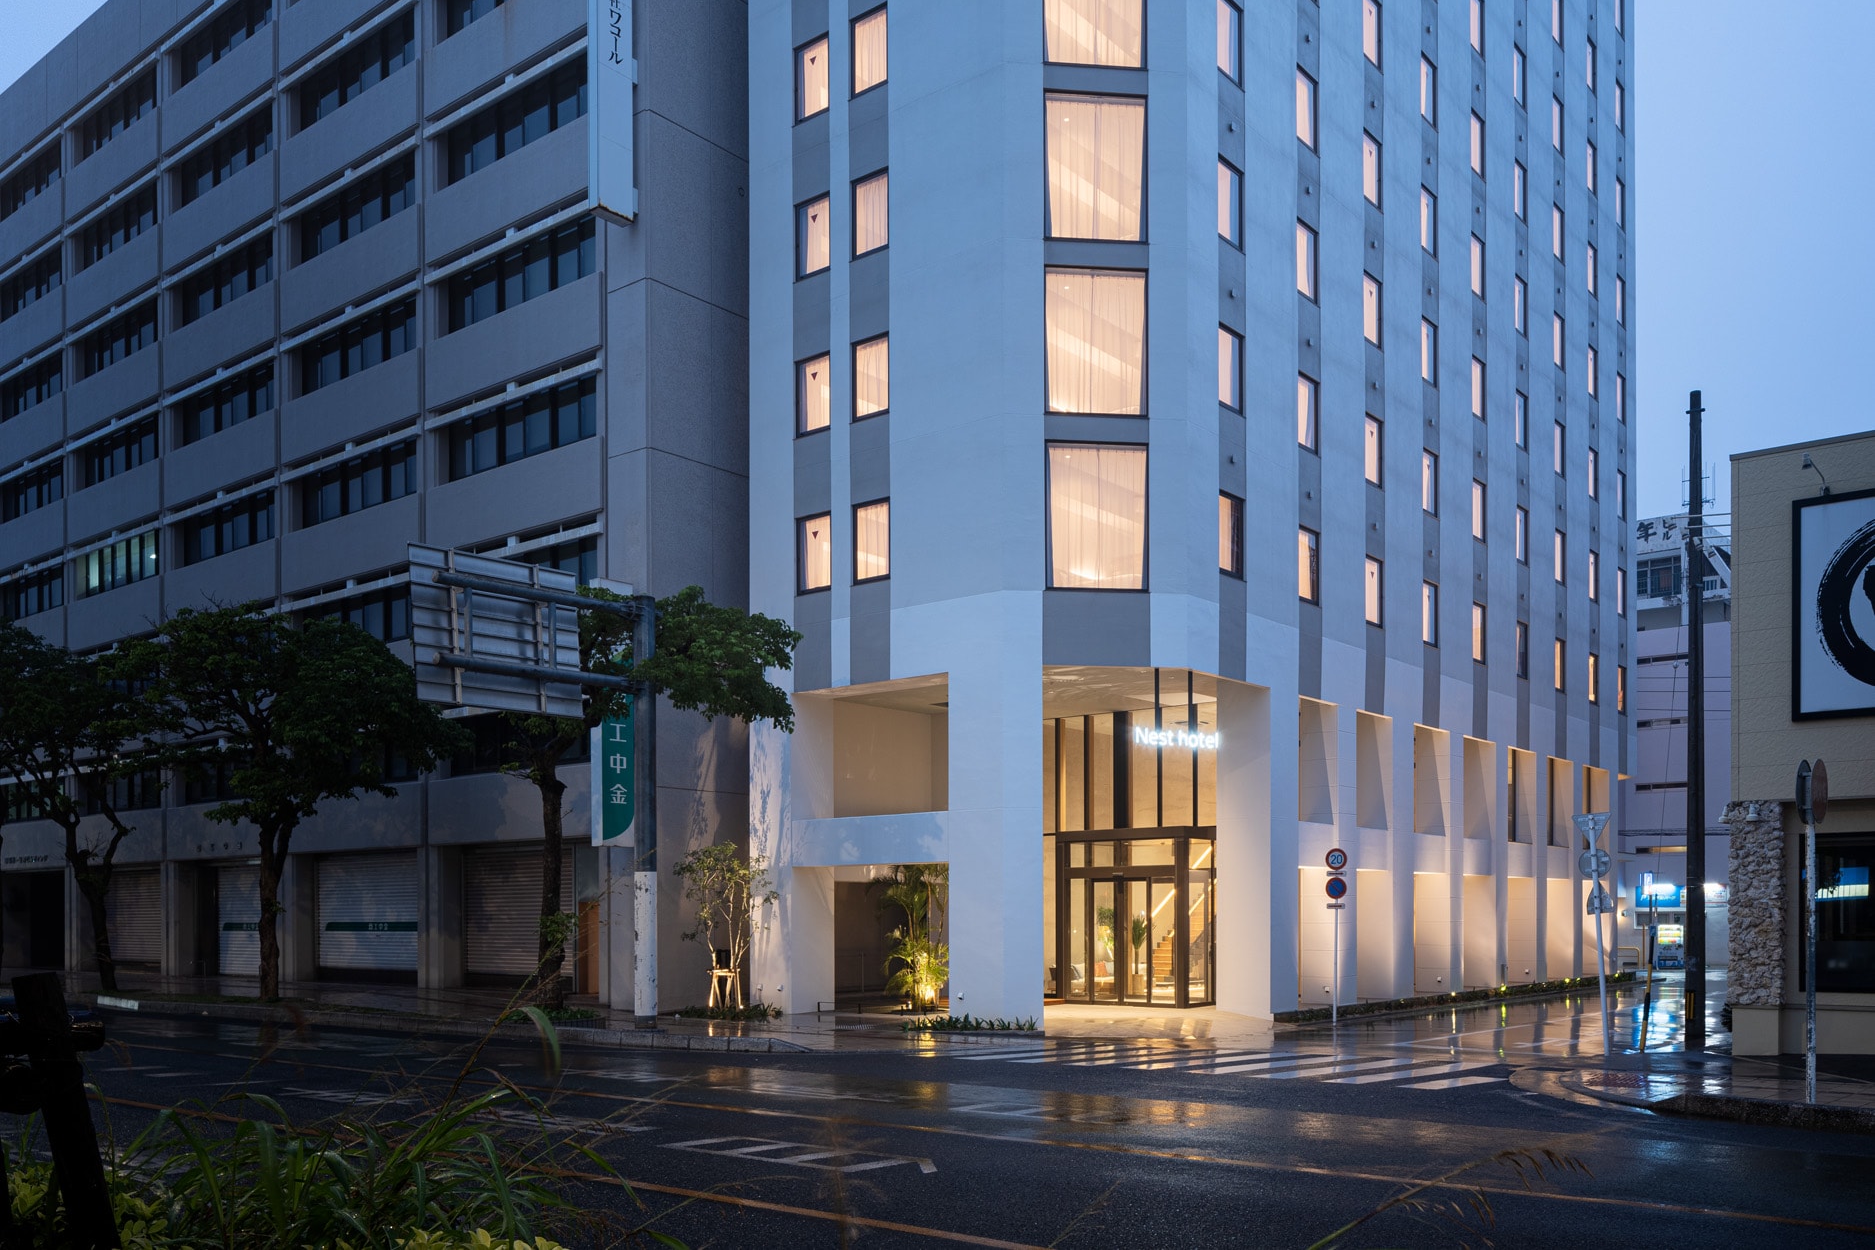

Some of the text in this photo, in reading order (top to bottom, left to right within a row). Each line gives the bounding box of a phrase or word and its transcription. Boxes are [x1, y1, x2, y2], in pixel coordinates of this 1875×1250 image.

[609, 693, 628, 805] 工中金
[1134, 726, 1219, 749] Nest hotel
[1330, 854, 1343, 865] 20
